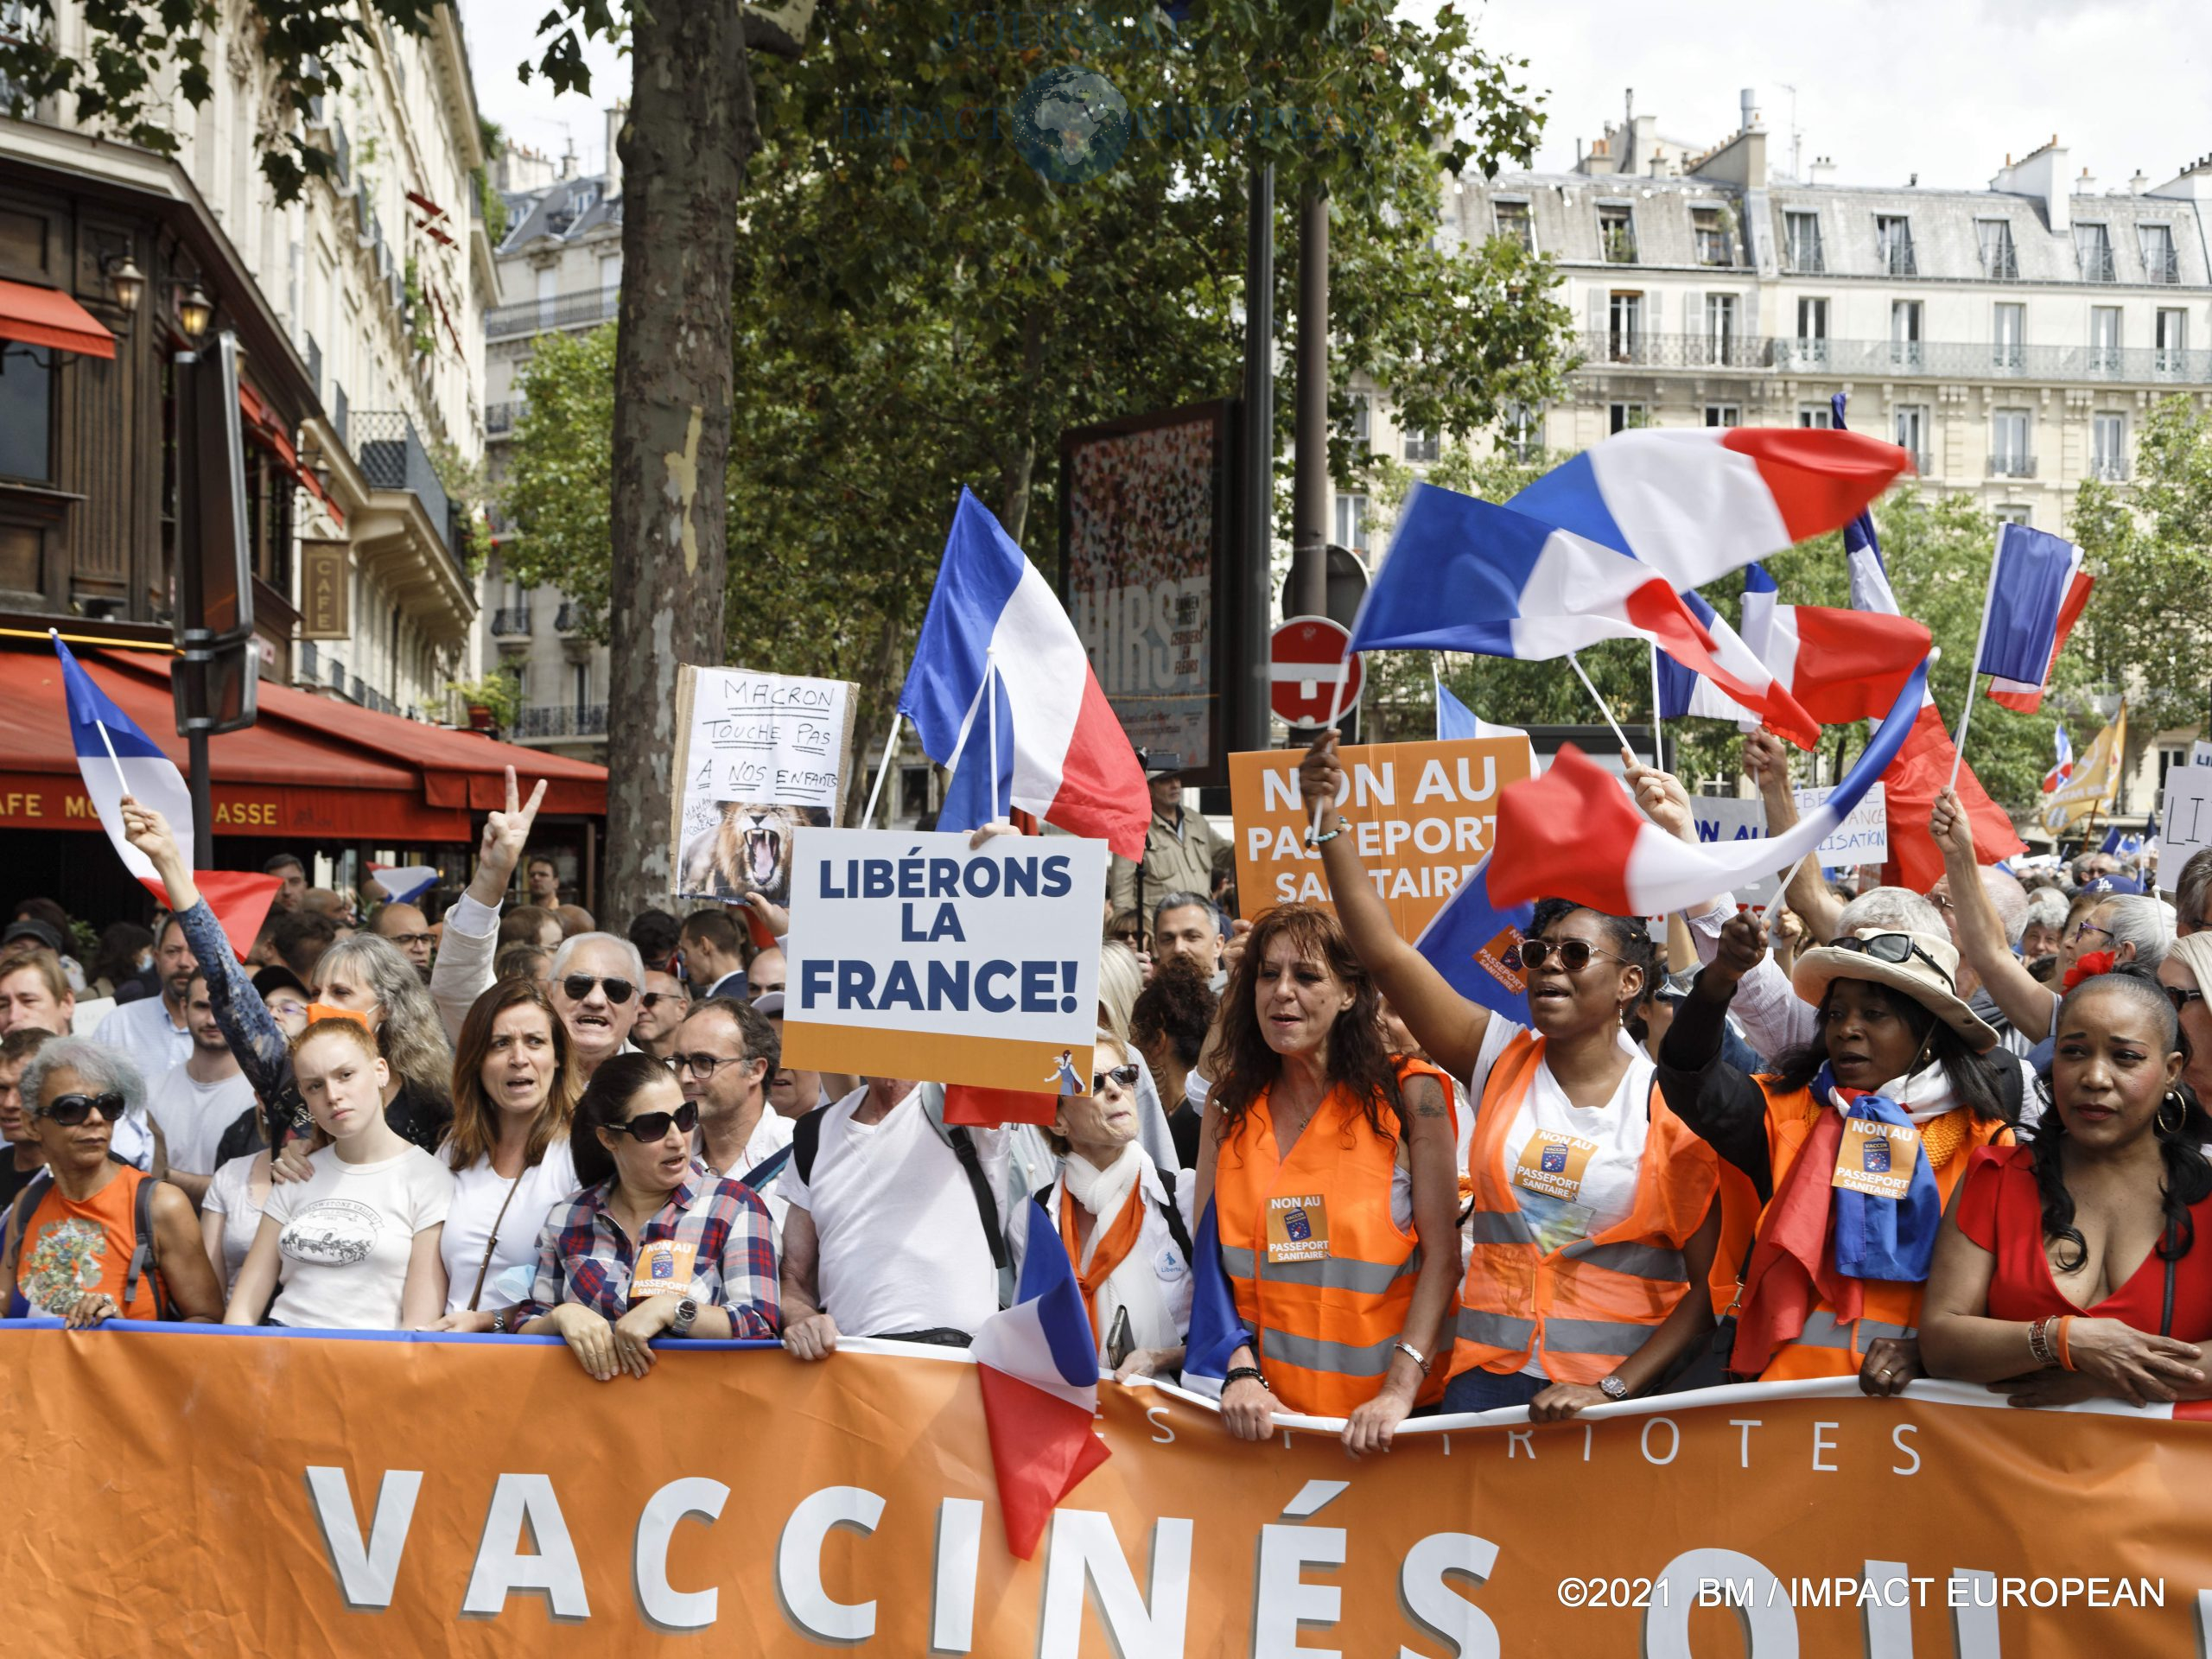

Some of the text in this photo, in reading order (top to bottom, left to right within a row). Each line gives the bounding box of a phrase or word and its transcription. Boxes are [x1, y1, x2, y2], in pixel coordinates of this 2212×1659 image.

[316, 560, 333, 629] CAFE
[1079, 575, 1211, 692] HIRST
[724, 678, 835, 707] MACRON
[702, 720, 830, 745] TOUCHE PAS
[696, 759, 712, 782] A
[729, 761, 767, 782] NOS
[2196, 753, 2212, 766] LI
[1262, 756, 1497, 811] NN AU
[1841, 809, 1885, 826] ANCE
[2166, 796, 2212, 847] LI
[1248, 816, 1497, 861] PASEPORT
[820, 847, 1071, 899] LIBÉRONS
[1275, 865, 1477, 904] SATAIR
[901, 902, 966, 943] LA
[1478, 948, 1526, 990] PASSEPORT
[1478, 958, 1515, 990] SANITAIRE
[801, 959, 1078, 1014] FRANCE!
[1538, 1131, 1594, 1150] NON AU
[1852, 1120, 1914, 1141] NON AU
[1517, 1166, 1580, 1191] PASSEPORT
[1522, 1179, 1569, 1198] SANITAIRE
[1836, 1166, 1910, 1189] PASSEPORT
[1843, 1179, 1899, 1198] SANITAIRE
[1271, 1196, 1321, 1209] NON AU
[646, 1241, 692, 1253] NON AU
[1269, 1240, 1329, 1252] PASSEPORT
[1278, 1250, 1323, 1261] SANITAIRE
[632, 1279, 690, 1292] PASSEPORT
[306, 1466, 1501, 1659] VACCINÉS
